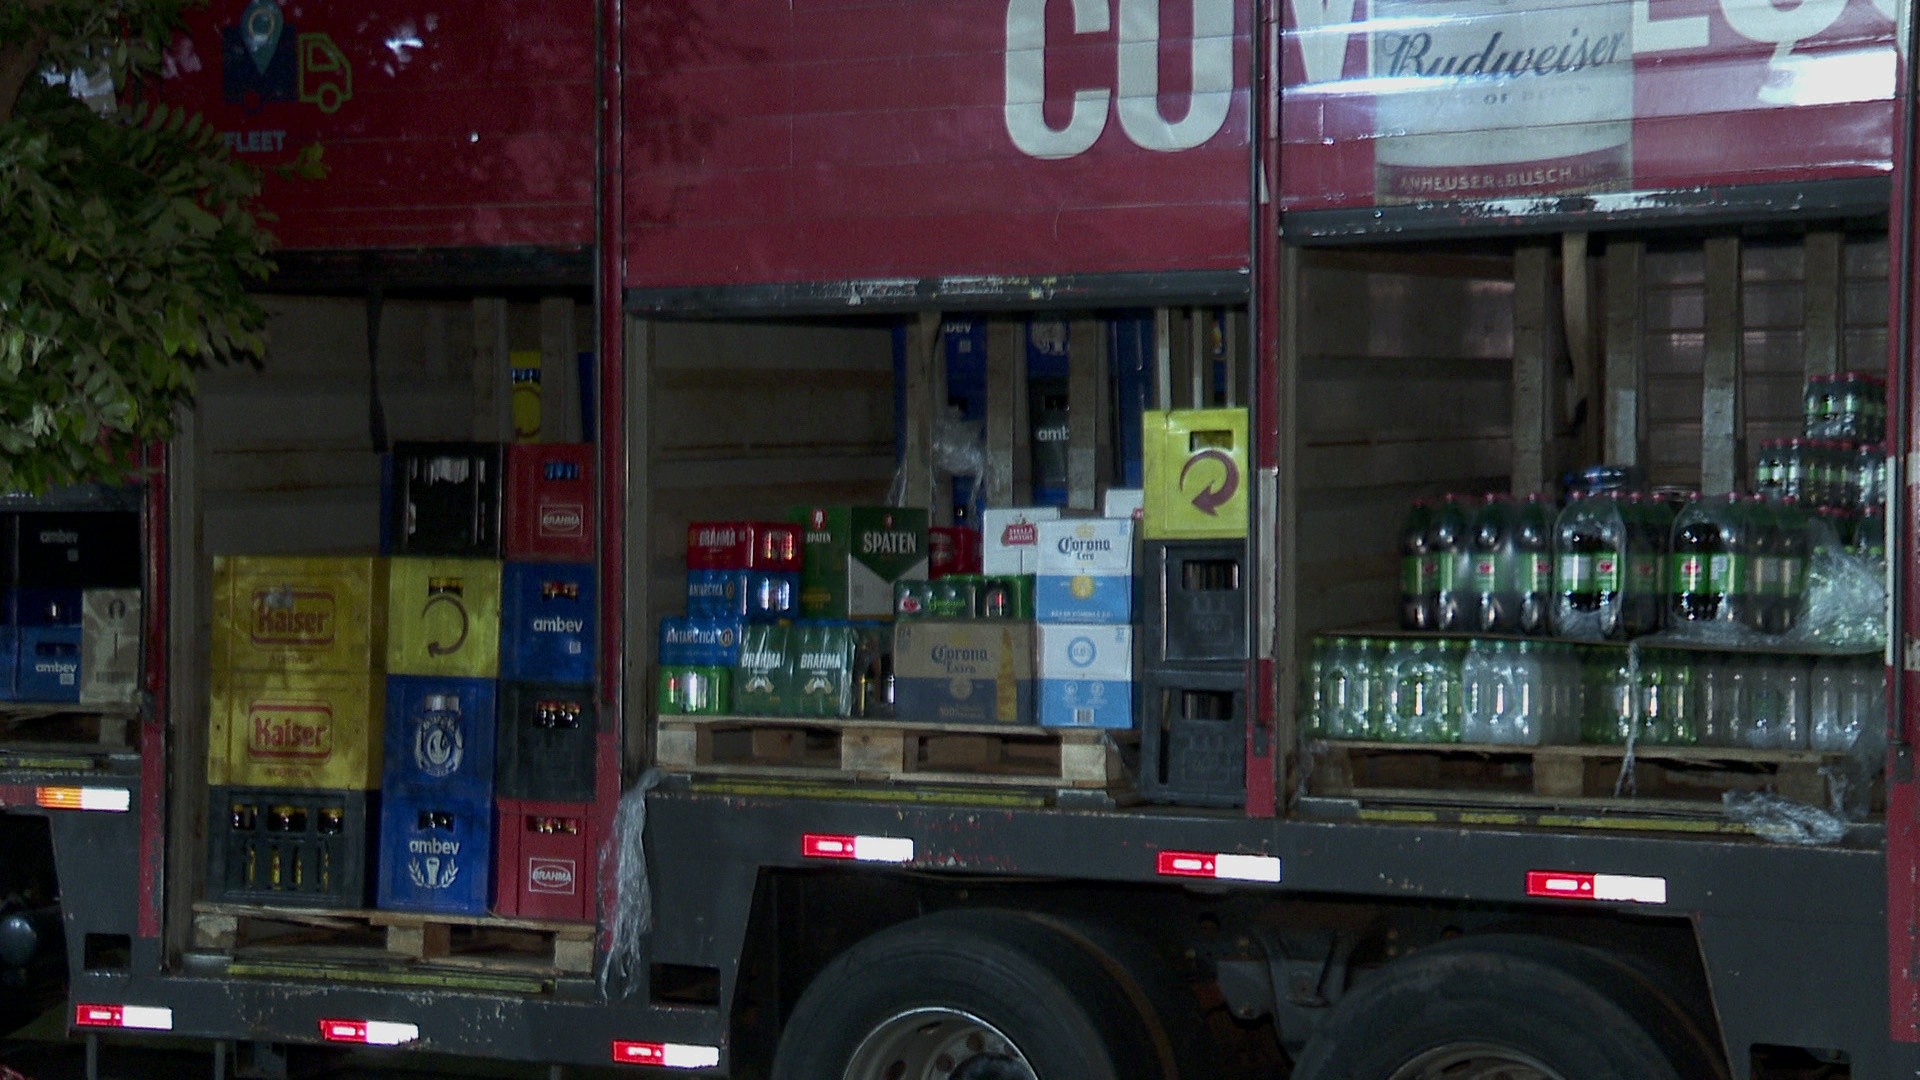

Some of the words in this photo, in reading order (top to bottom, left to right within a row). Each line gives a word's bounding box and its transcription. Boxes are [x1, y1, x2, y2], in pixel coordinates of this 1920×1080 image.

[1384, 28, 1626, 80] Budweiser
[223, 130, 287, 153] FLEET
[1037, 425, 1069, 441] amb
[543, 514, 580, 526] BRAHMA
[40, 529, 79, 544] ambev
[699, 527, 736, 547] BRAHMA
[806, 531, 832, 544] SPATEN
[1009, 527, 1033, 535] STELLA
[863, 531, 917, 555] SPATEN
[1057, 536, 1111, 558] Corona
[258, 602, 330, 634] Kaiser
[533, 615, 584, 633] ambev
[666, 629, 716, 644] ANTARCTICA
[741, 652, 781, 669] BRAHMA
[800, 652, 841, 669] BRAHMA
[931, 644, 988, 665] Corona
[35, 661, 78, 672] ambev
[255, 717, 327, 747] Kaiser
[409, 837, 460, 855] ambev
[533, 869, 572, 882] BRAHMA
